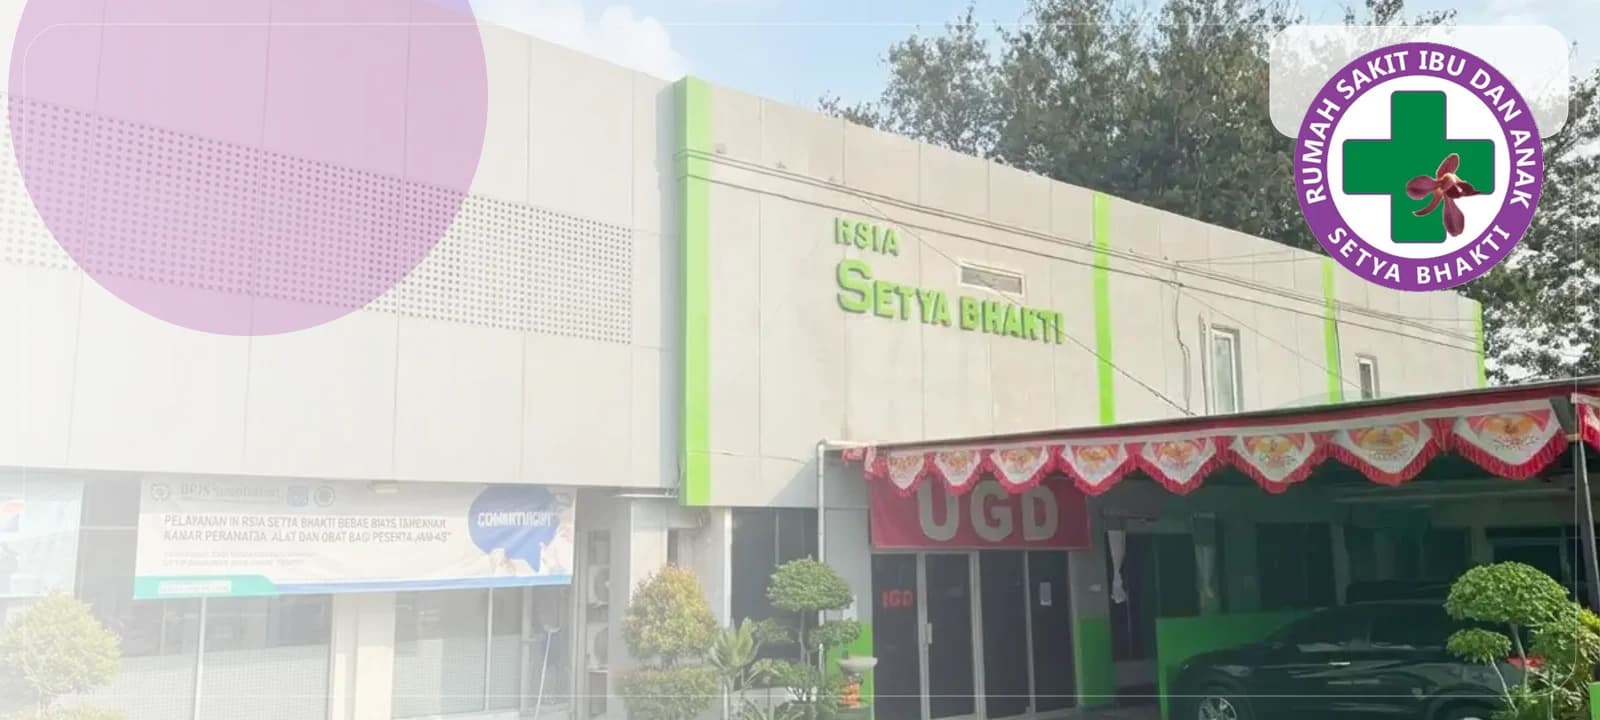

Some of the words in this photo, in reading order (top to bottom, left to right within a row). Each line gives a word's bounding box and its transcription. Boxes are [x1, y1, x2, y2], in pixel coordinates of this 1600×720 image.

[835, 217, 900, 257] RSIA
[836, 258, 952, 328] SETYA
[960, 296, 1066, 345] BHAKTI
[918, 476, 1058, 542] UGD
[880, 589, 913, 608] IGD
